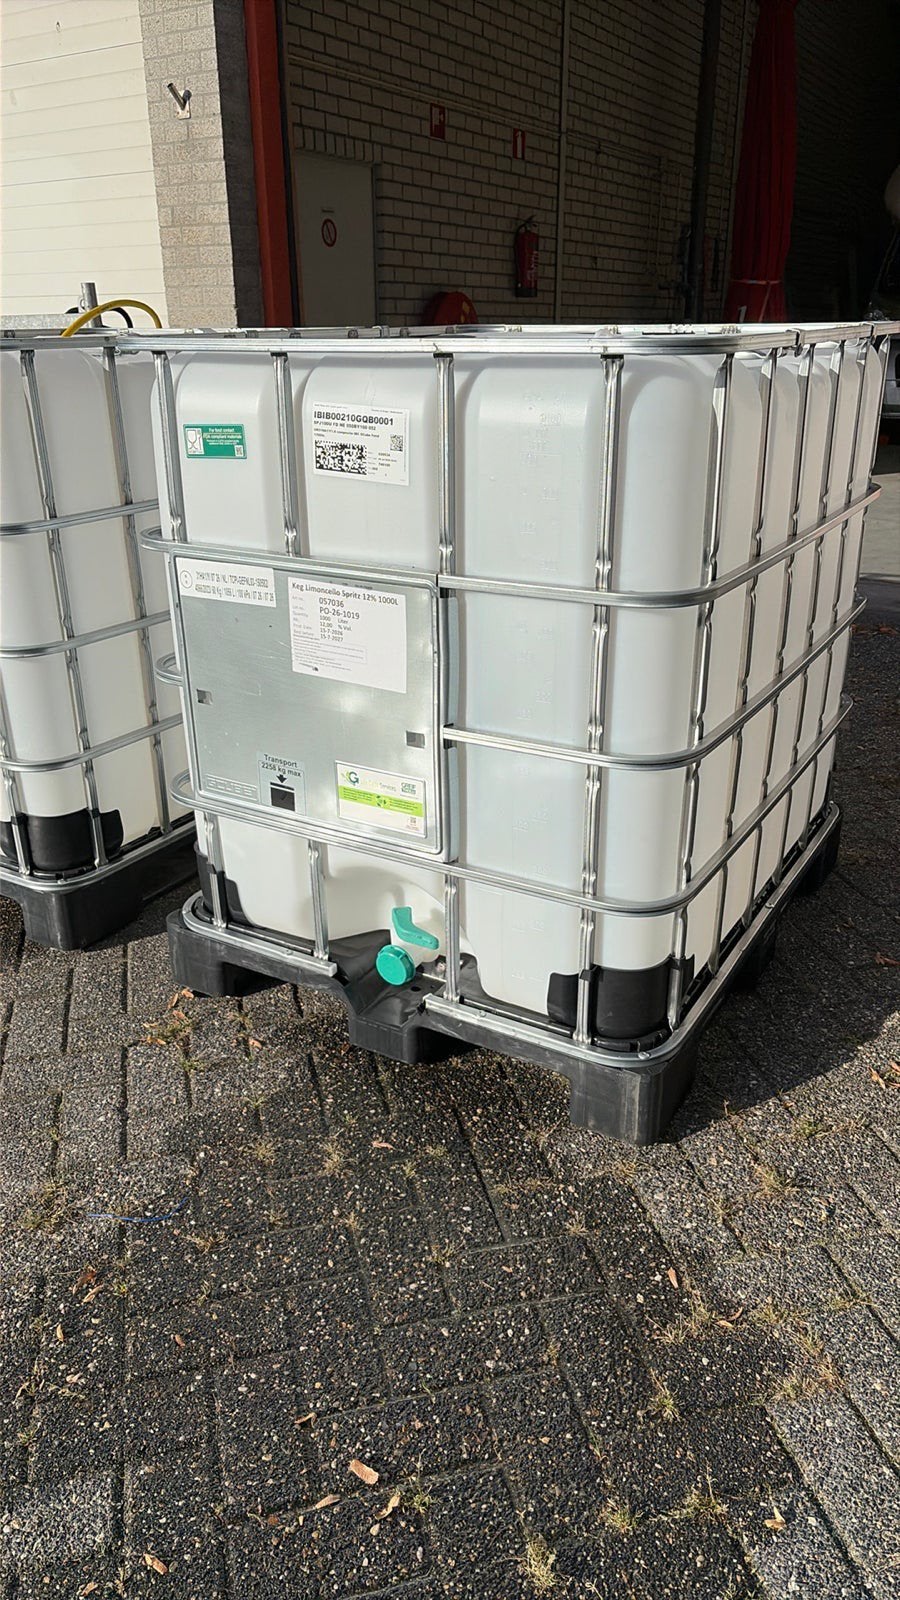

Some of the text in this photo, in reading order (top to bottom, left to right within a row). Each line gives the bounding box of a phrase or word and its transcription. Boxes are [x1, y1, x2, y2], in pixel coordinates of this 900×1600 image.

[314, 411, 394, 426] IBIB00210GQB0001
[292, 582, 304, 592] Keg
[305, 584, 340, 596] Limoncello
[342, 590, 361, 599] Spritz
[363, 593, 376, 602] 12%
[378, 596, 398, 605] 1000L
[319, 597, 344, 608] 057036
[320, 606, 360, 619] PO-26-1019
[264, 754, 298, 768] Transport
[278, 765, 286, 774] kg
[288, 769, 302, 777] max
